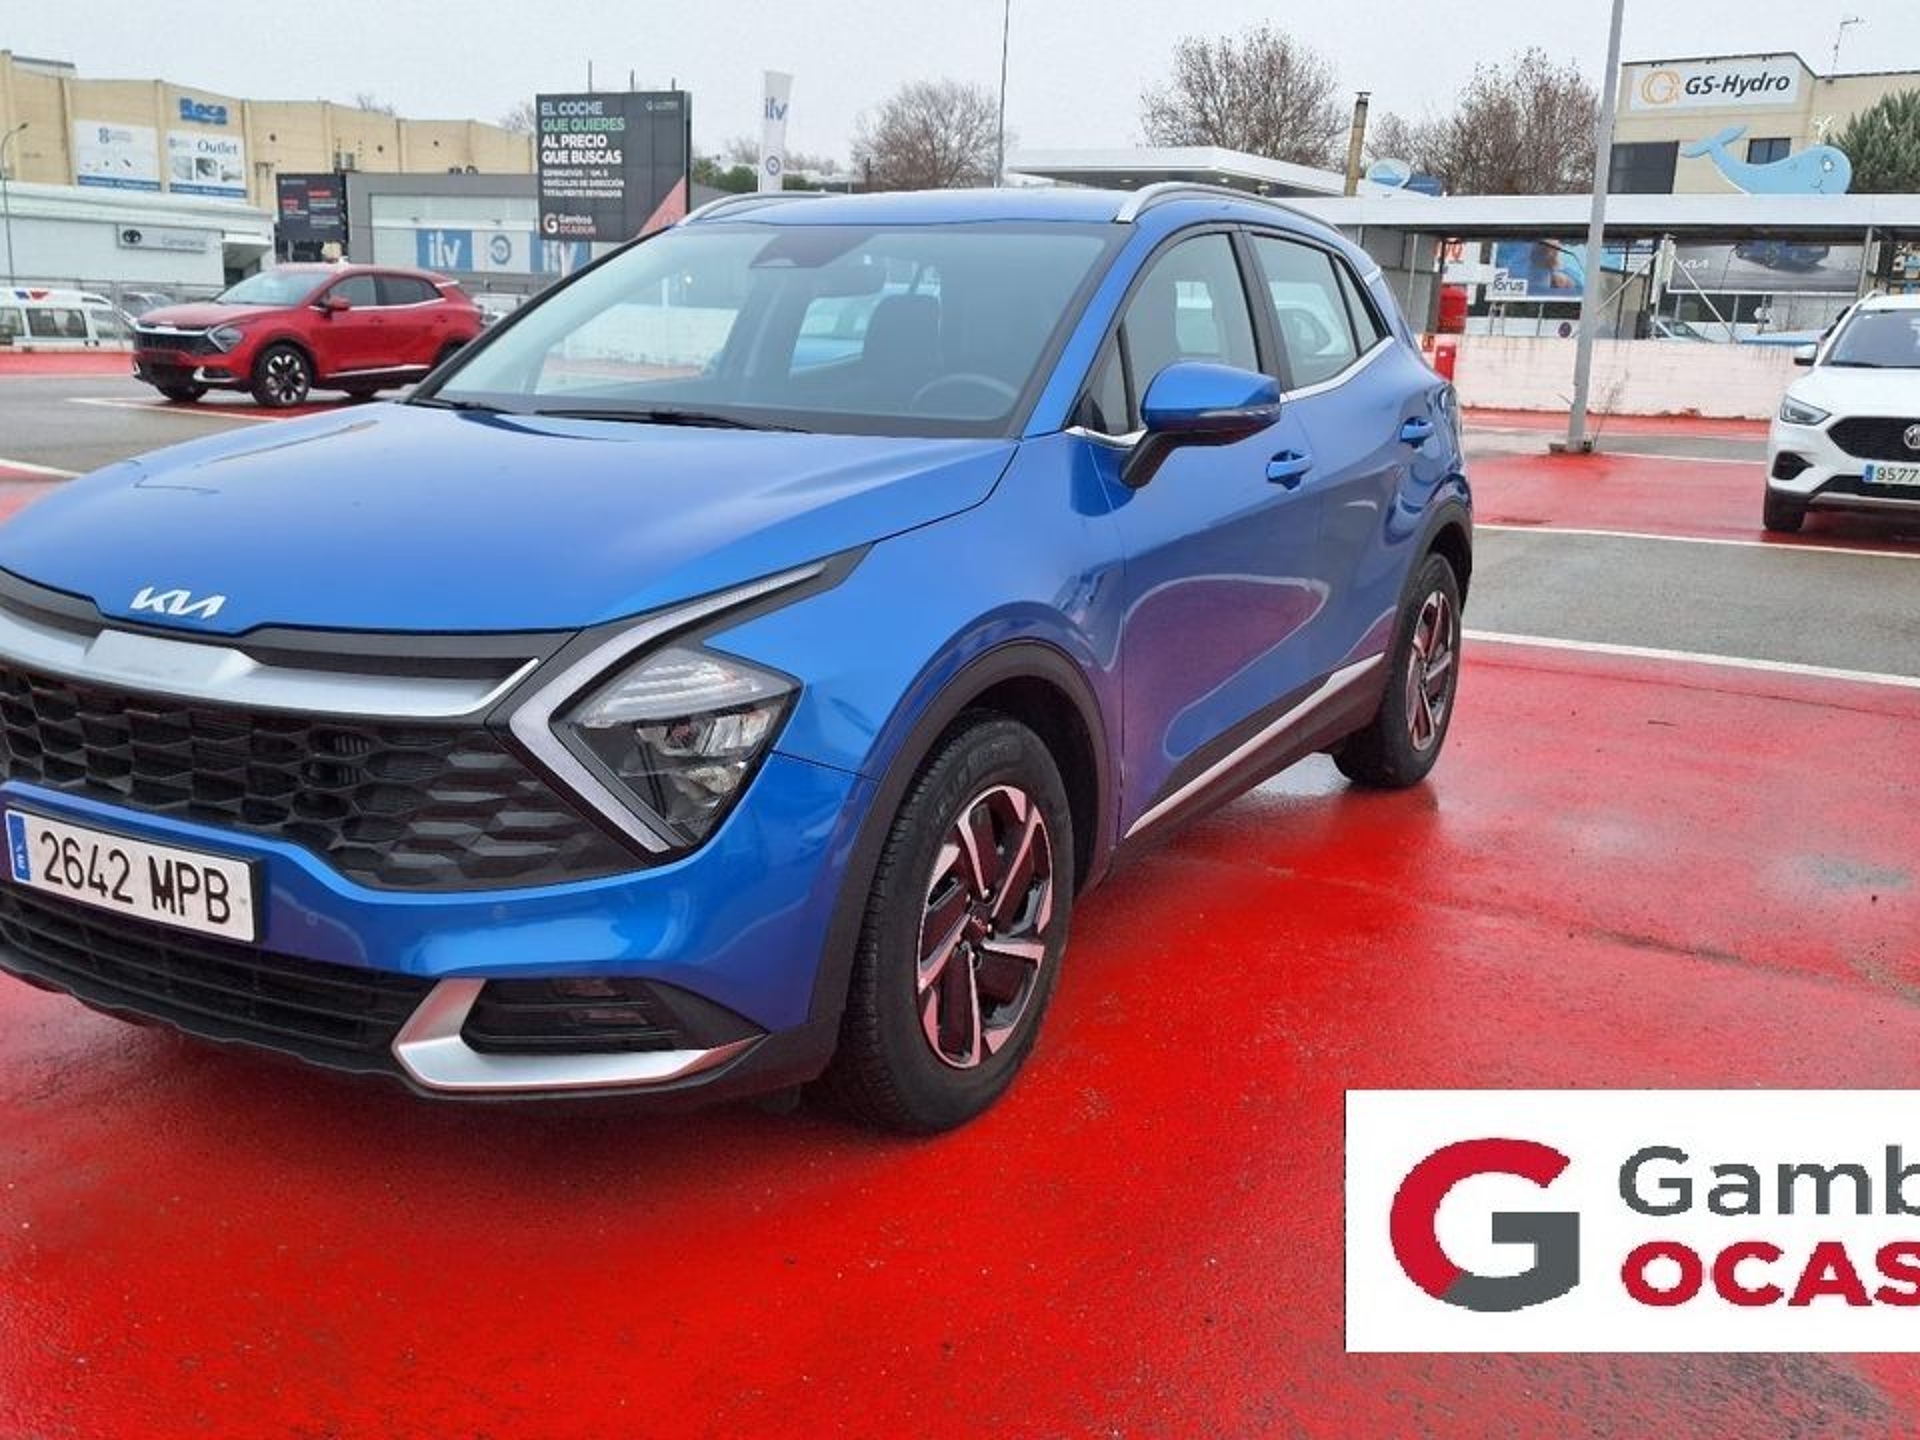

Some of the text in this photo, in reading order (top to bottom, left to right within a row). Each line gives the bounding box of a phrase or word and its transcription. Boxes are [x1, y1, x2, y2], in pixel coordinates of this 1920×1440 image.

[1685, 71, 1790, 97] GS-Hydro
[541, 101, 603, 115] EL COCHE
[541, 117, 625, 132] QUE QUIERES
[198, 139, 237, 155] Outlet
[542, 134, 607, 148] AL PRECIO
[541, 149, 623, 165] QUE BUSCAS
[1875, 467, 1919, 482] 9577
[129, 586, 226, 619] KIA
[40, 831, 231, 924] 2642 MPB
